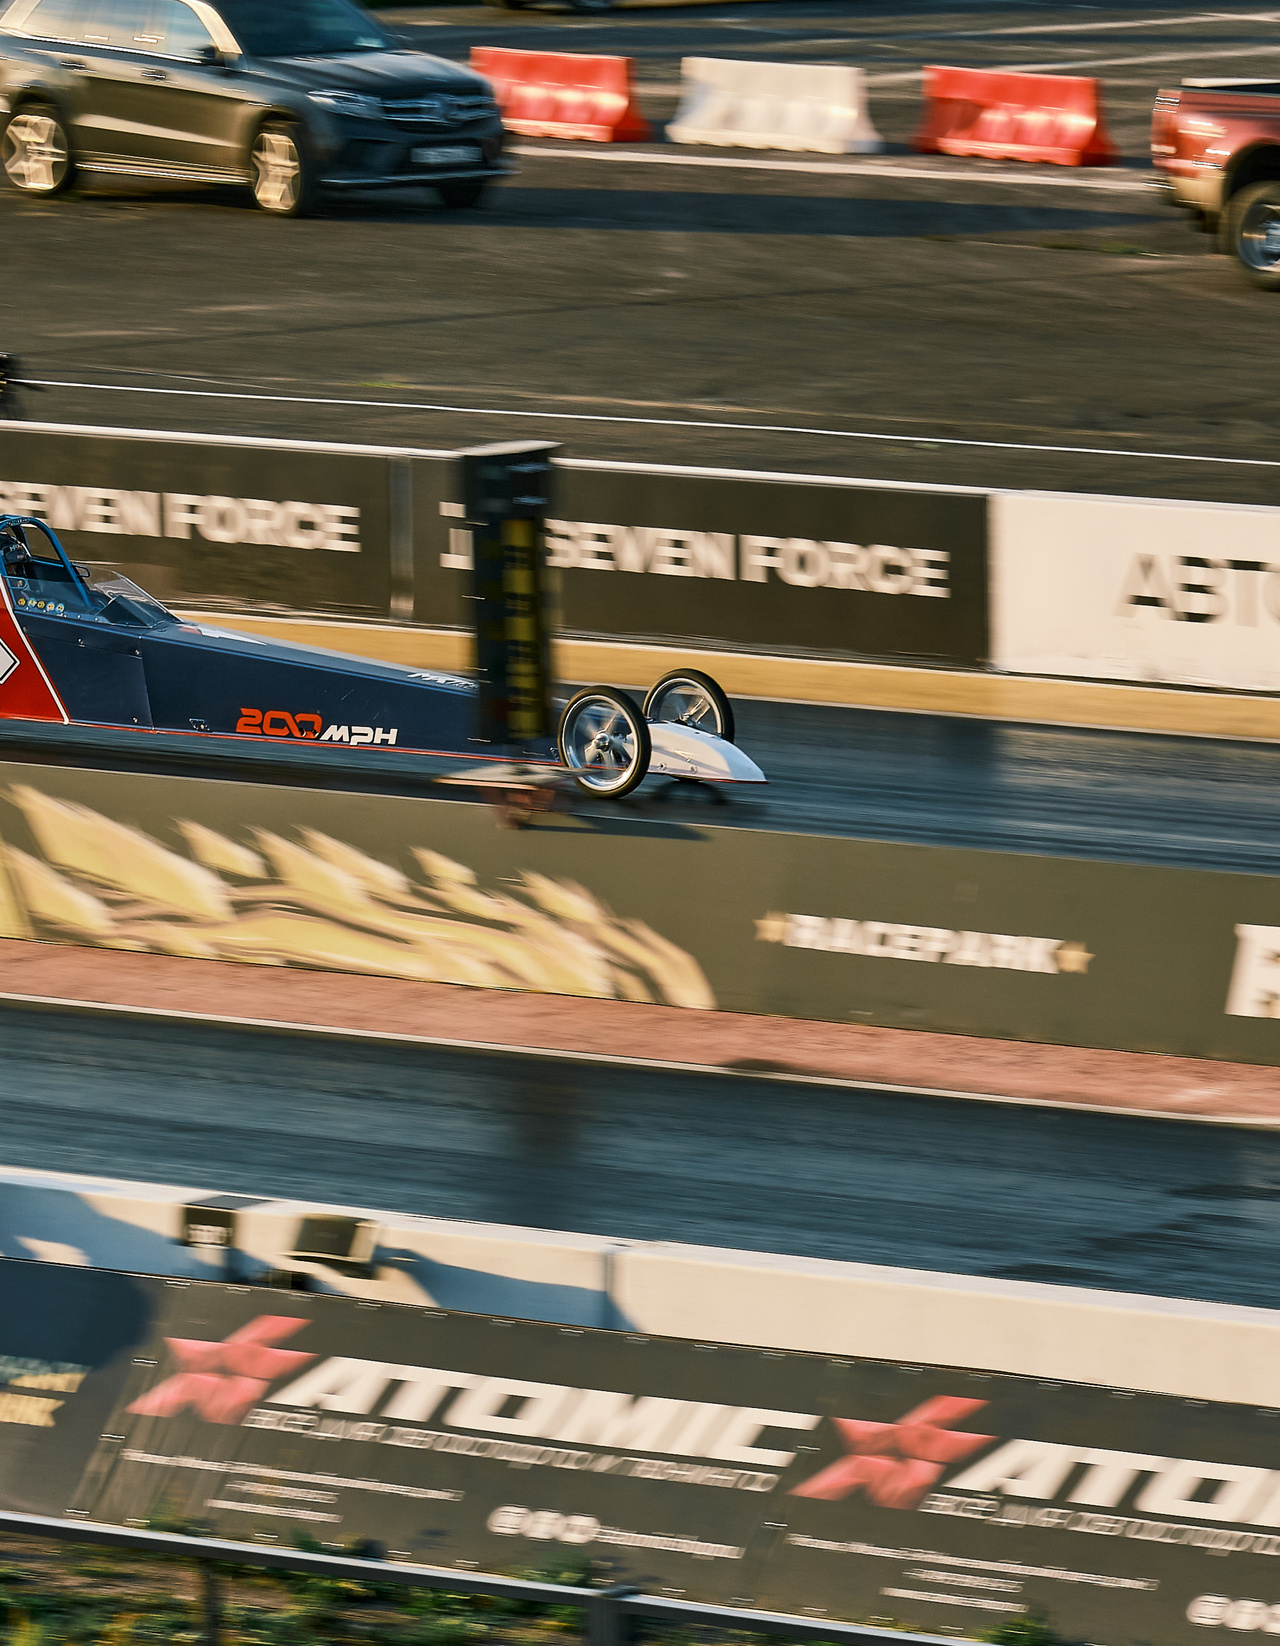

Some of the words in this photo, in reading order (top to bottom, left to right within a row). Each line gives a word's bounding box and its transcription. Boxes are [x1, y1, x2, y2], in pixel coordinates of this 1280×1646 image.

[163, 491, 361, 553] FORCE
[544, 517, 737, 581] SEVEN
[740, 533, 951, 599] FORCE
[1112, 552, 1280, 629] АВТ
[236, 707, 323, 739] 200
[319, 724, 399, 746] MPH
[783, 912, 1065, 975] RACEPARK
[264, 1356, 823, 1467] ATOMIC
